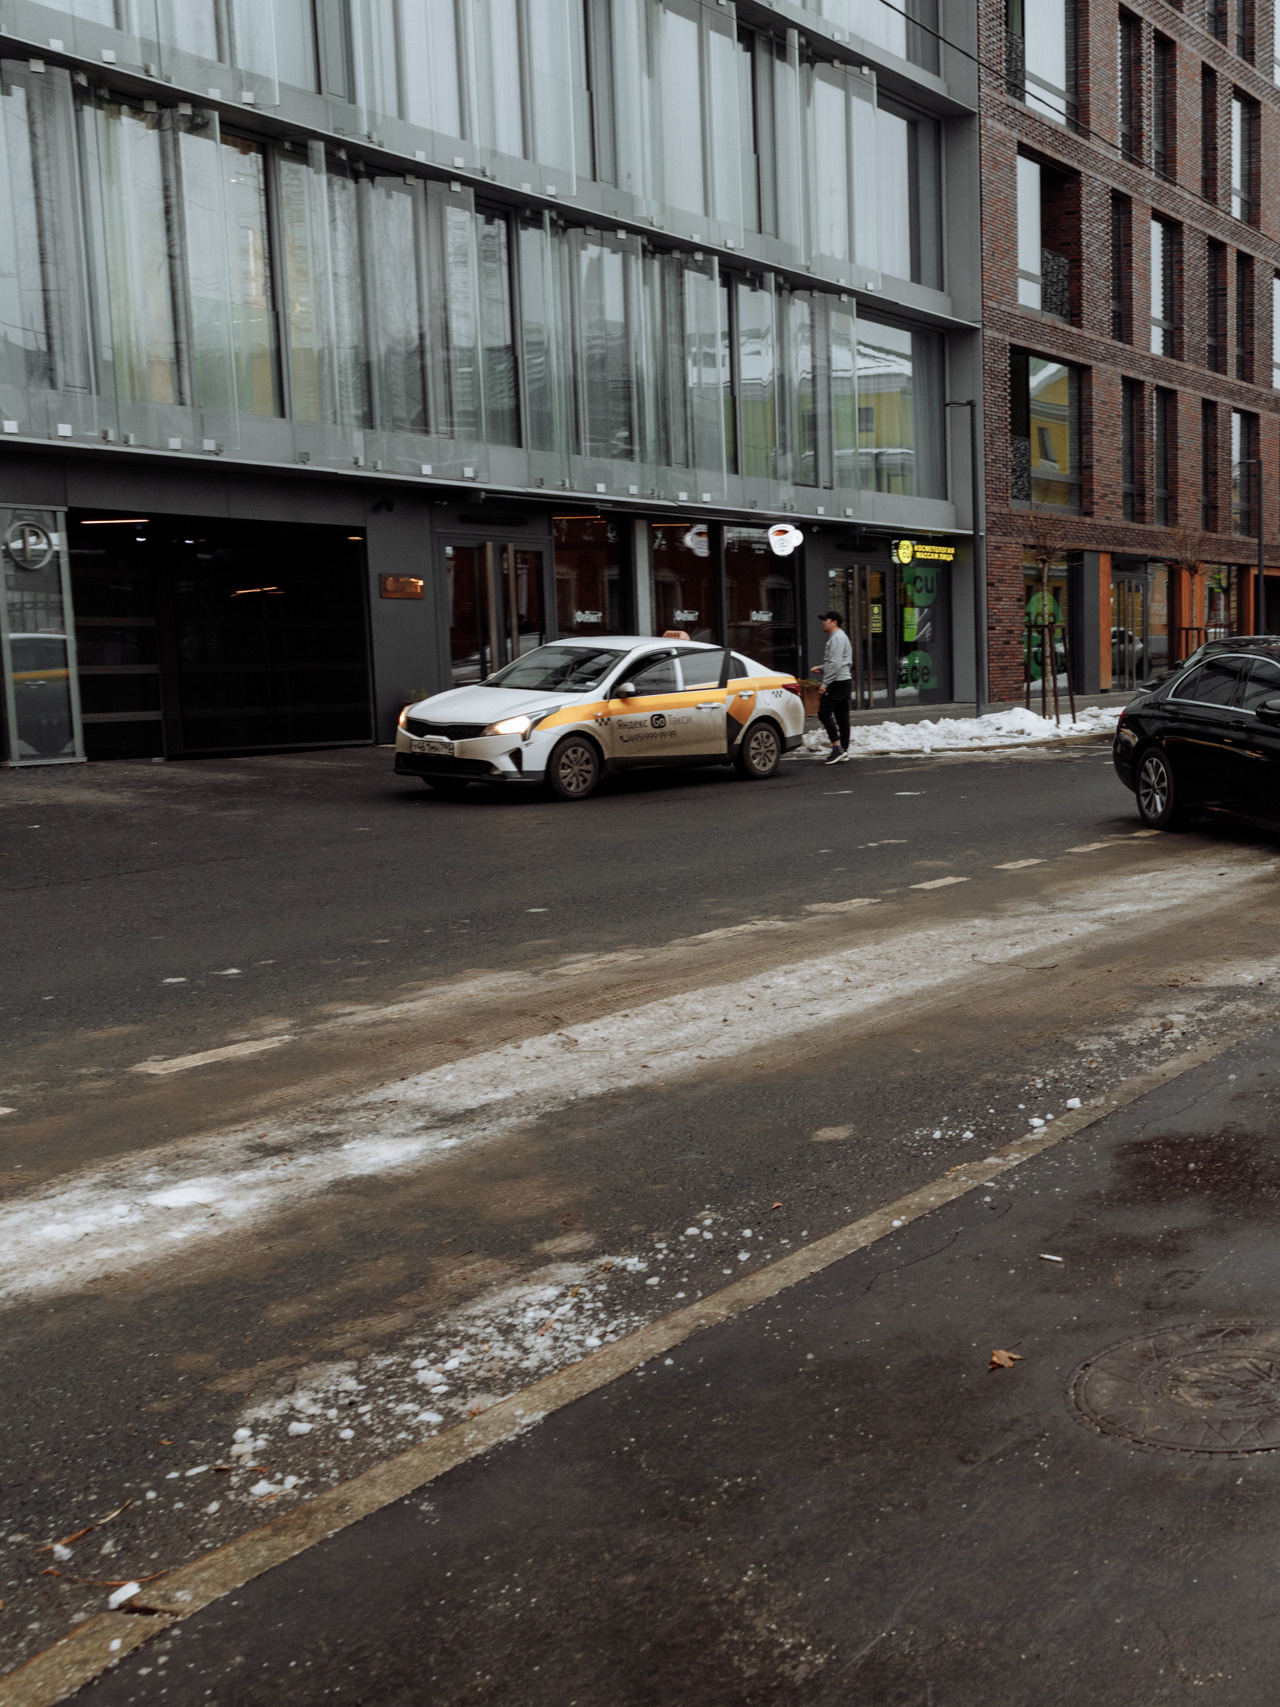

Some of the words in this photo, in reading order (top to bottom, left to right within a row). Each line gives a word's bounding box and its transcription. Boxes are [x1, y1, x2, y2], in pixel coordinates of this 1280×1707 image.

[616, 718, 649, 730] Яндекс
[652, 715, 666, 727] Go
[667, 714, 693, 726] Такси
